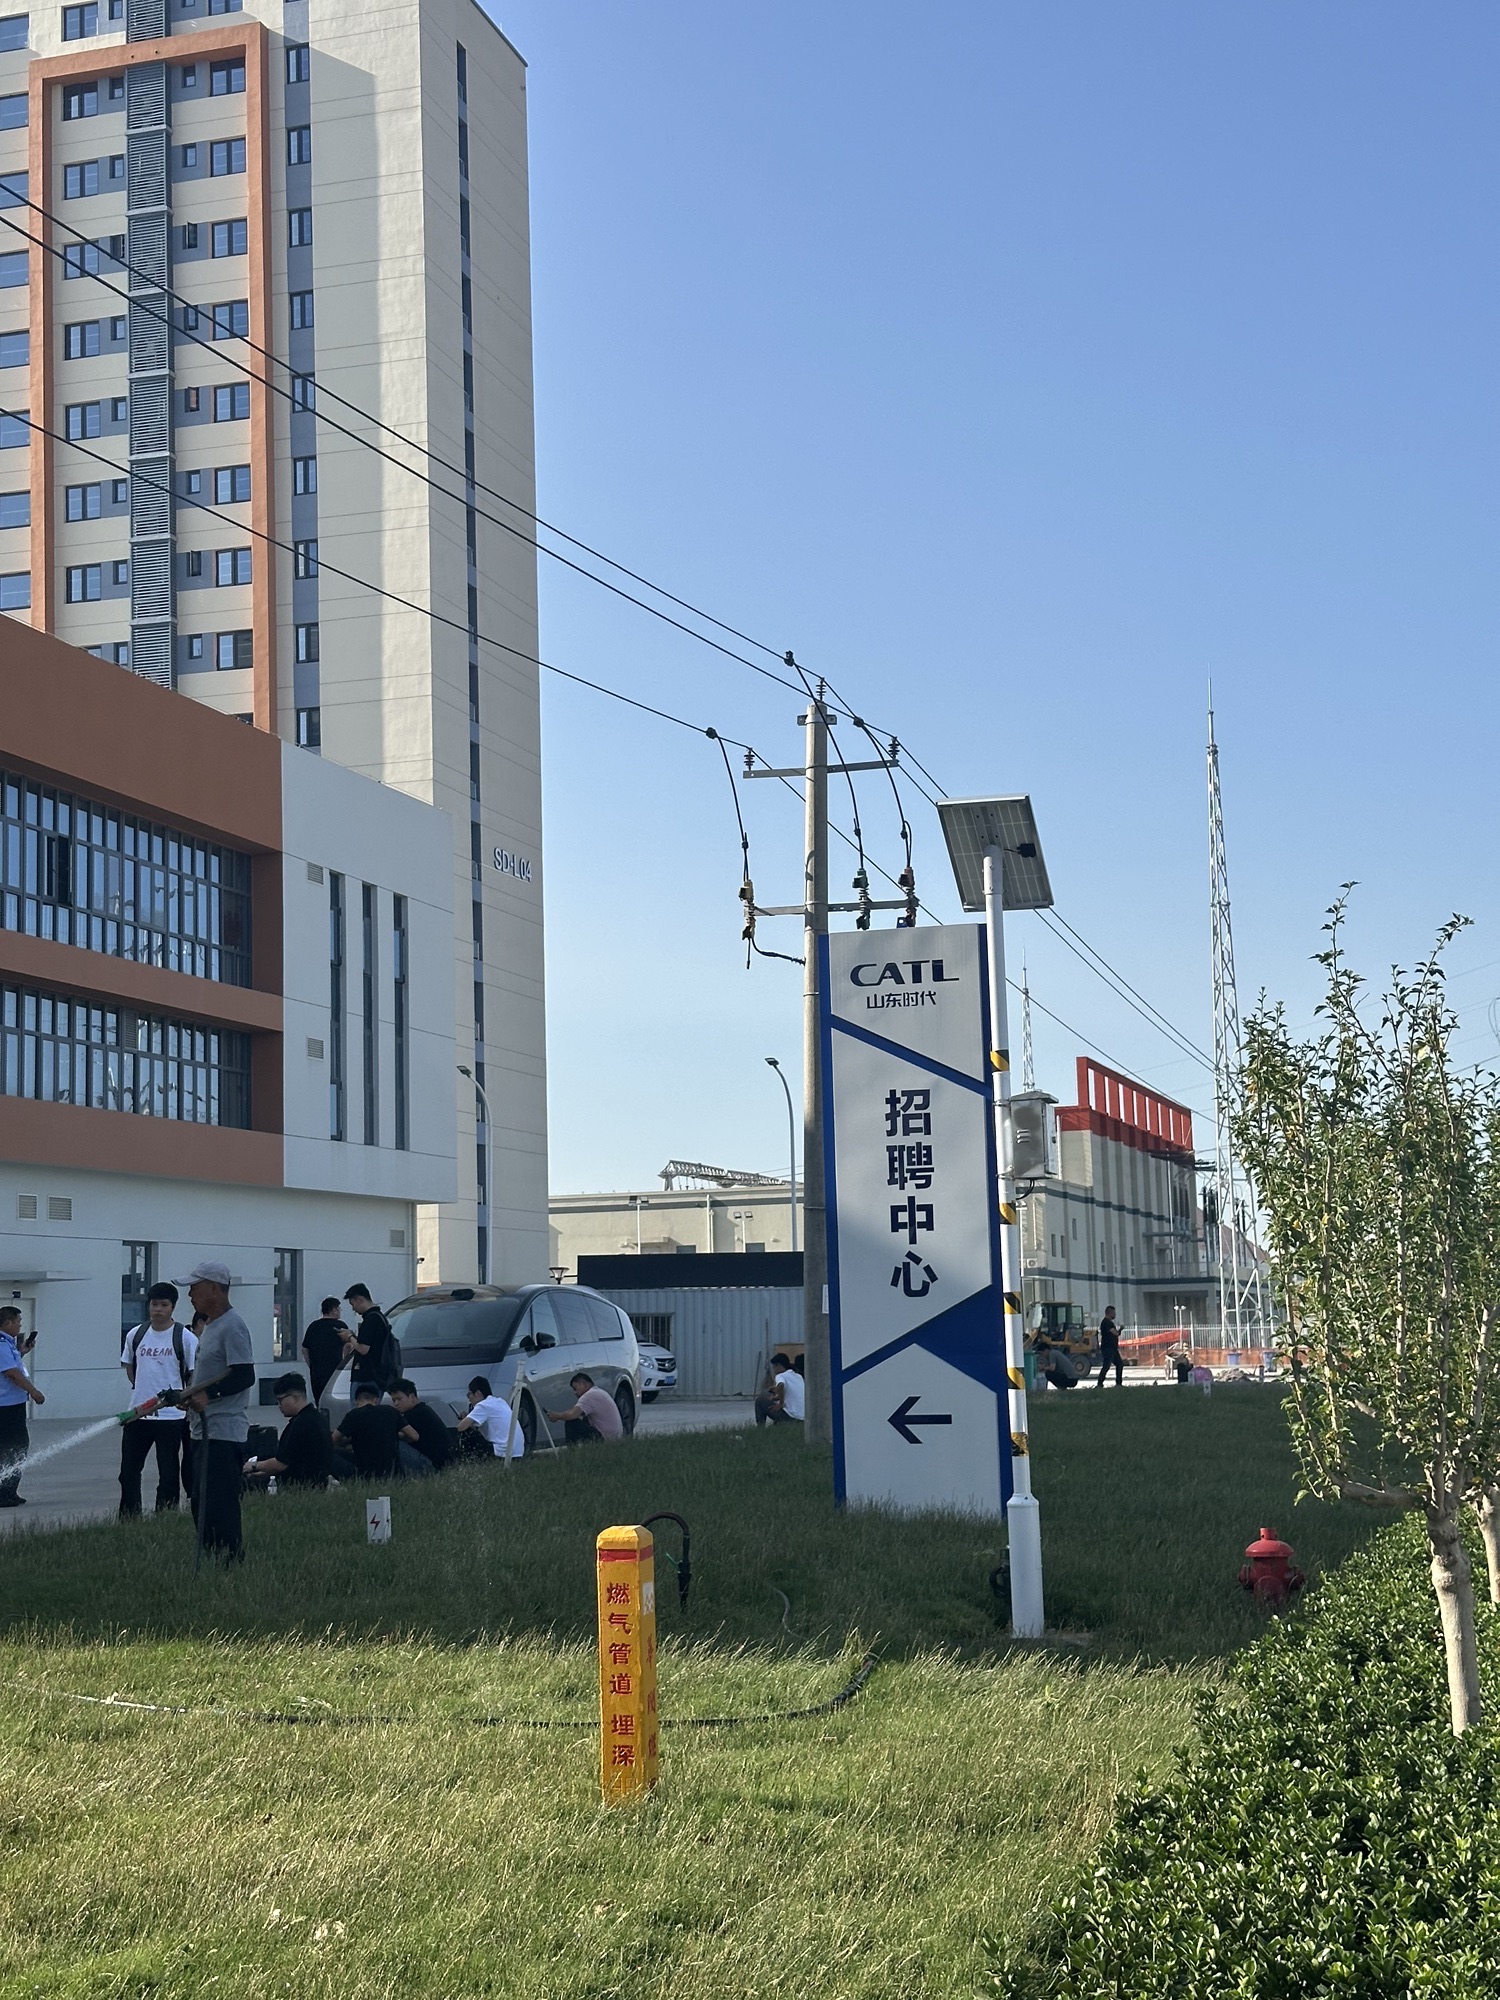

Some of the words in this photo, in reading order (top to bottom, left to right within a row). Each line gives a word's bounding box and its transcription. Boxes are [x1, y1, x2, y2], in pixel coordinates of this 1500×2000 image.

[850, 959, 960, 987] CATL
[866, 990, 937, 1009] 山东时代
[885, 1088, 939, 1298] 招聘中心
[140, 1347, 173, 1357] DREAM
